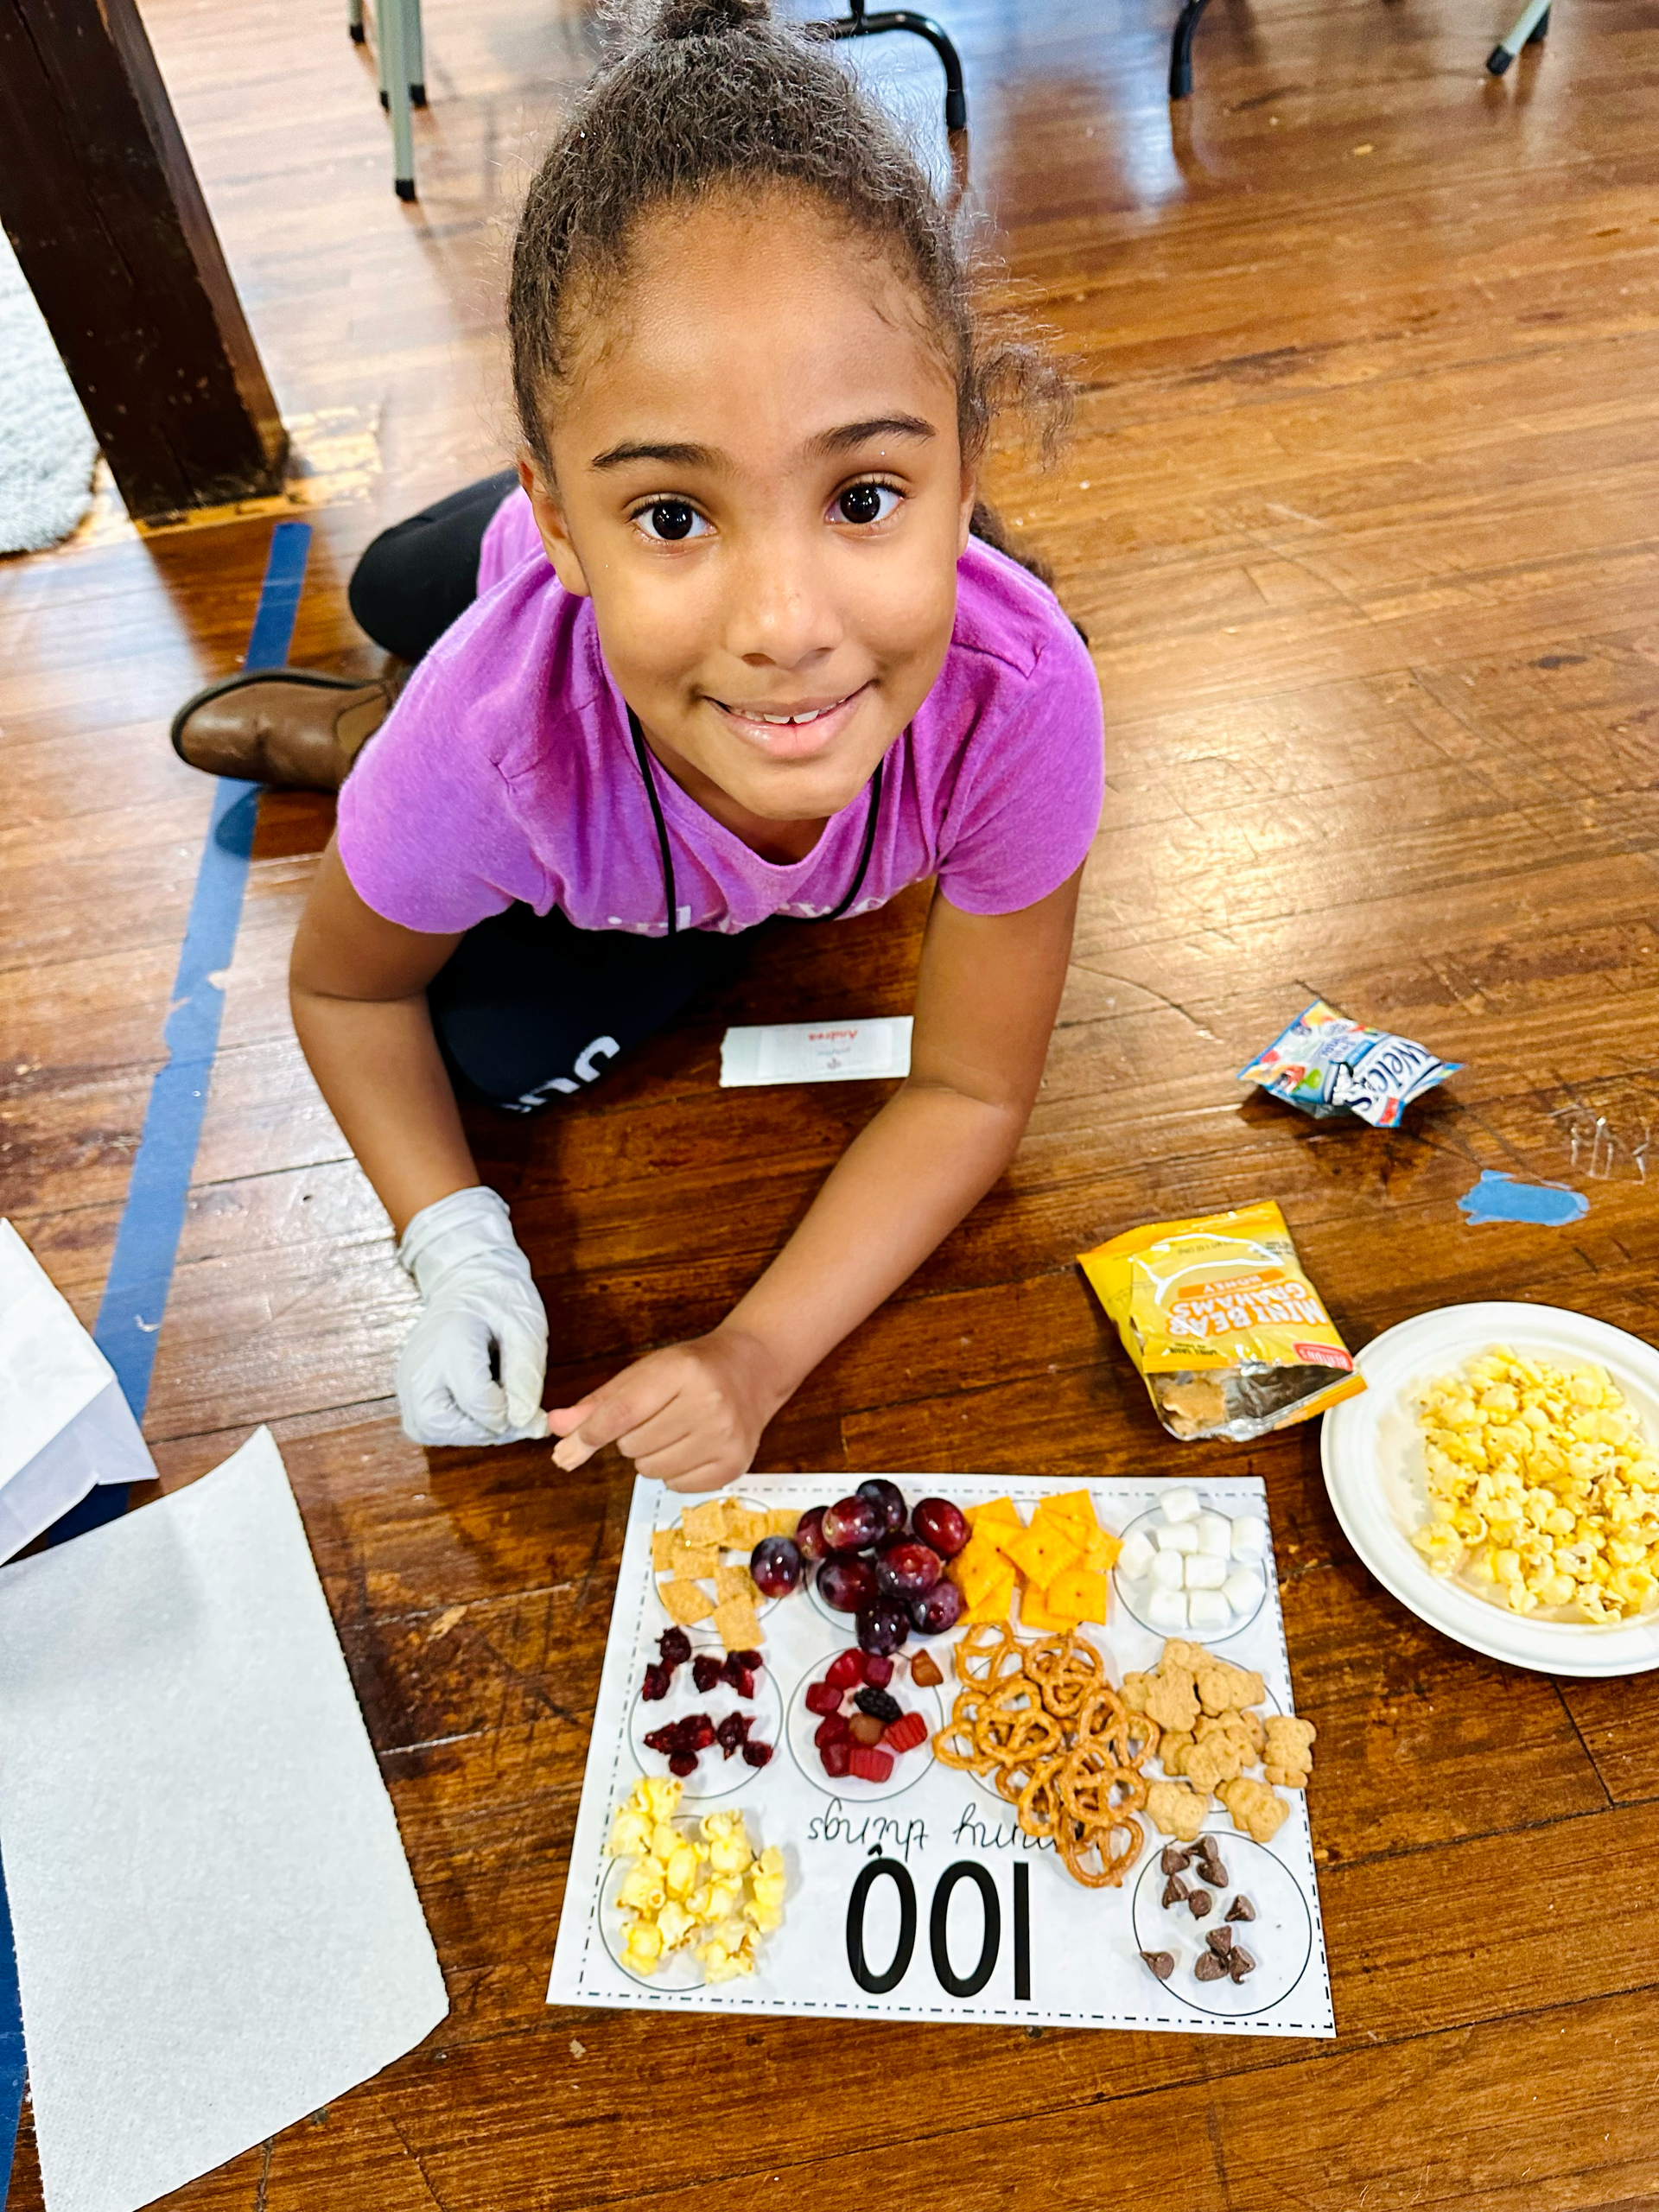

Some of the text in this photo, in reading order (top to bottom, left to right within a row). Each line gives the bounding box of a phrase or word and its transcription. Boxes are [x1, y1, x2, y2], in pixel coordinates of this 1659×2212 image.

[1344, 1041, 1429, 1112] Welc's
[1172, 1281, 1306, 1318] GRAHAMS
[1203, 1274, 1262, 1293] HONEY
[1168, 1297, 1328, 1337] MINI BEAR
[808, 1797, 1057, 1863] mmy things
[846, 1857, 1031, 2000] 100
